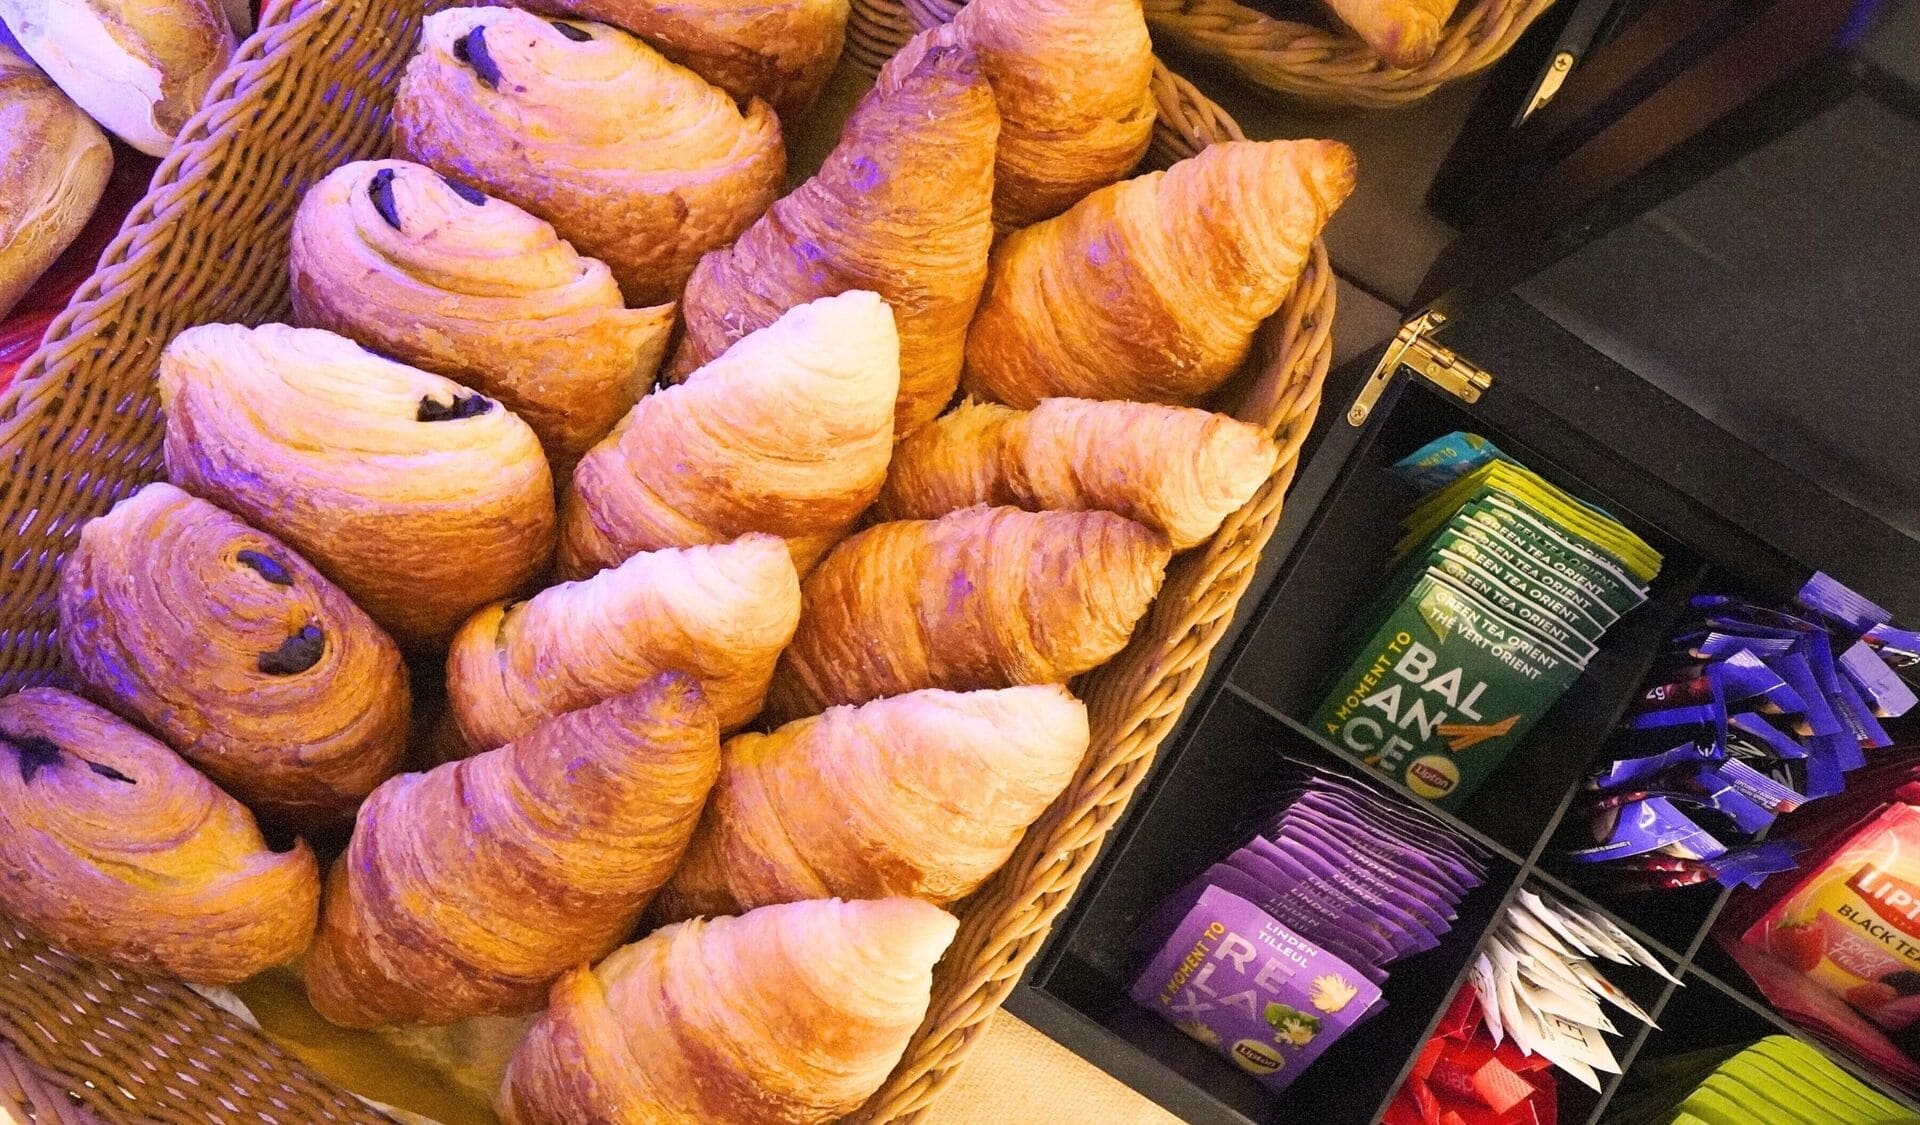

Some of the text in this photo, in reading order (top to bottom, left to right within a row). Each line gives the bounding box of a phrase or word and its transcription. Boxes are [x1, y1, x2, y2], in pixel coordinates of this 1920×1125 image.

[1458, 544, 1580, 623] GREEN TEA ORIENT
[1515, 558, 1539, 578] TEA
[1541, 575, 1592, 609] ORIENT
[1527, 544, 1551, 564] TEA
[1553, 561, 1605, 595] ORIENT
[1436, 592, 1559, 669] GREEN TEA ORIENT
[1446, 564, 1570, 642] GREEN TEA ORIENT
[1430, 607, 1542, 680] THÉ VERT ORIENT
[1326, 631, 1411, 735] A MOMENT TO
[1393, 641, 1488, 721] BAL
[1361, 684, 1448, 742] AN
[1342, 716, 1414, 771] CE
[1413, 763, 1451, 788] Lipton
[1270, 898, 1320, 927] LINDEN
[1291, 888, 1340, 920] LINDEN
[1837, 904, 1896, 944] BLACK
[1168, 940, 1210, 994] MOMENT
[1204, 921, 1225, 942] TO
[1213, 931, 1297, 995] RE
[1257, 930, 1308, 969] TILLEUL
[1265, 922, 1318, 957] LINDEN
[1239, 1045, 1277, 1068] Lipton
